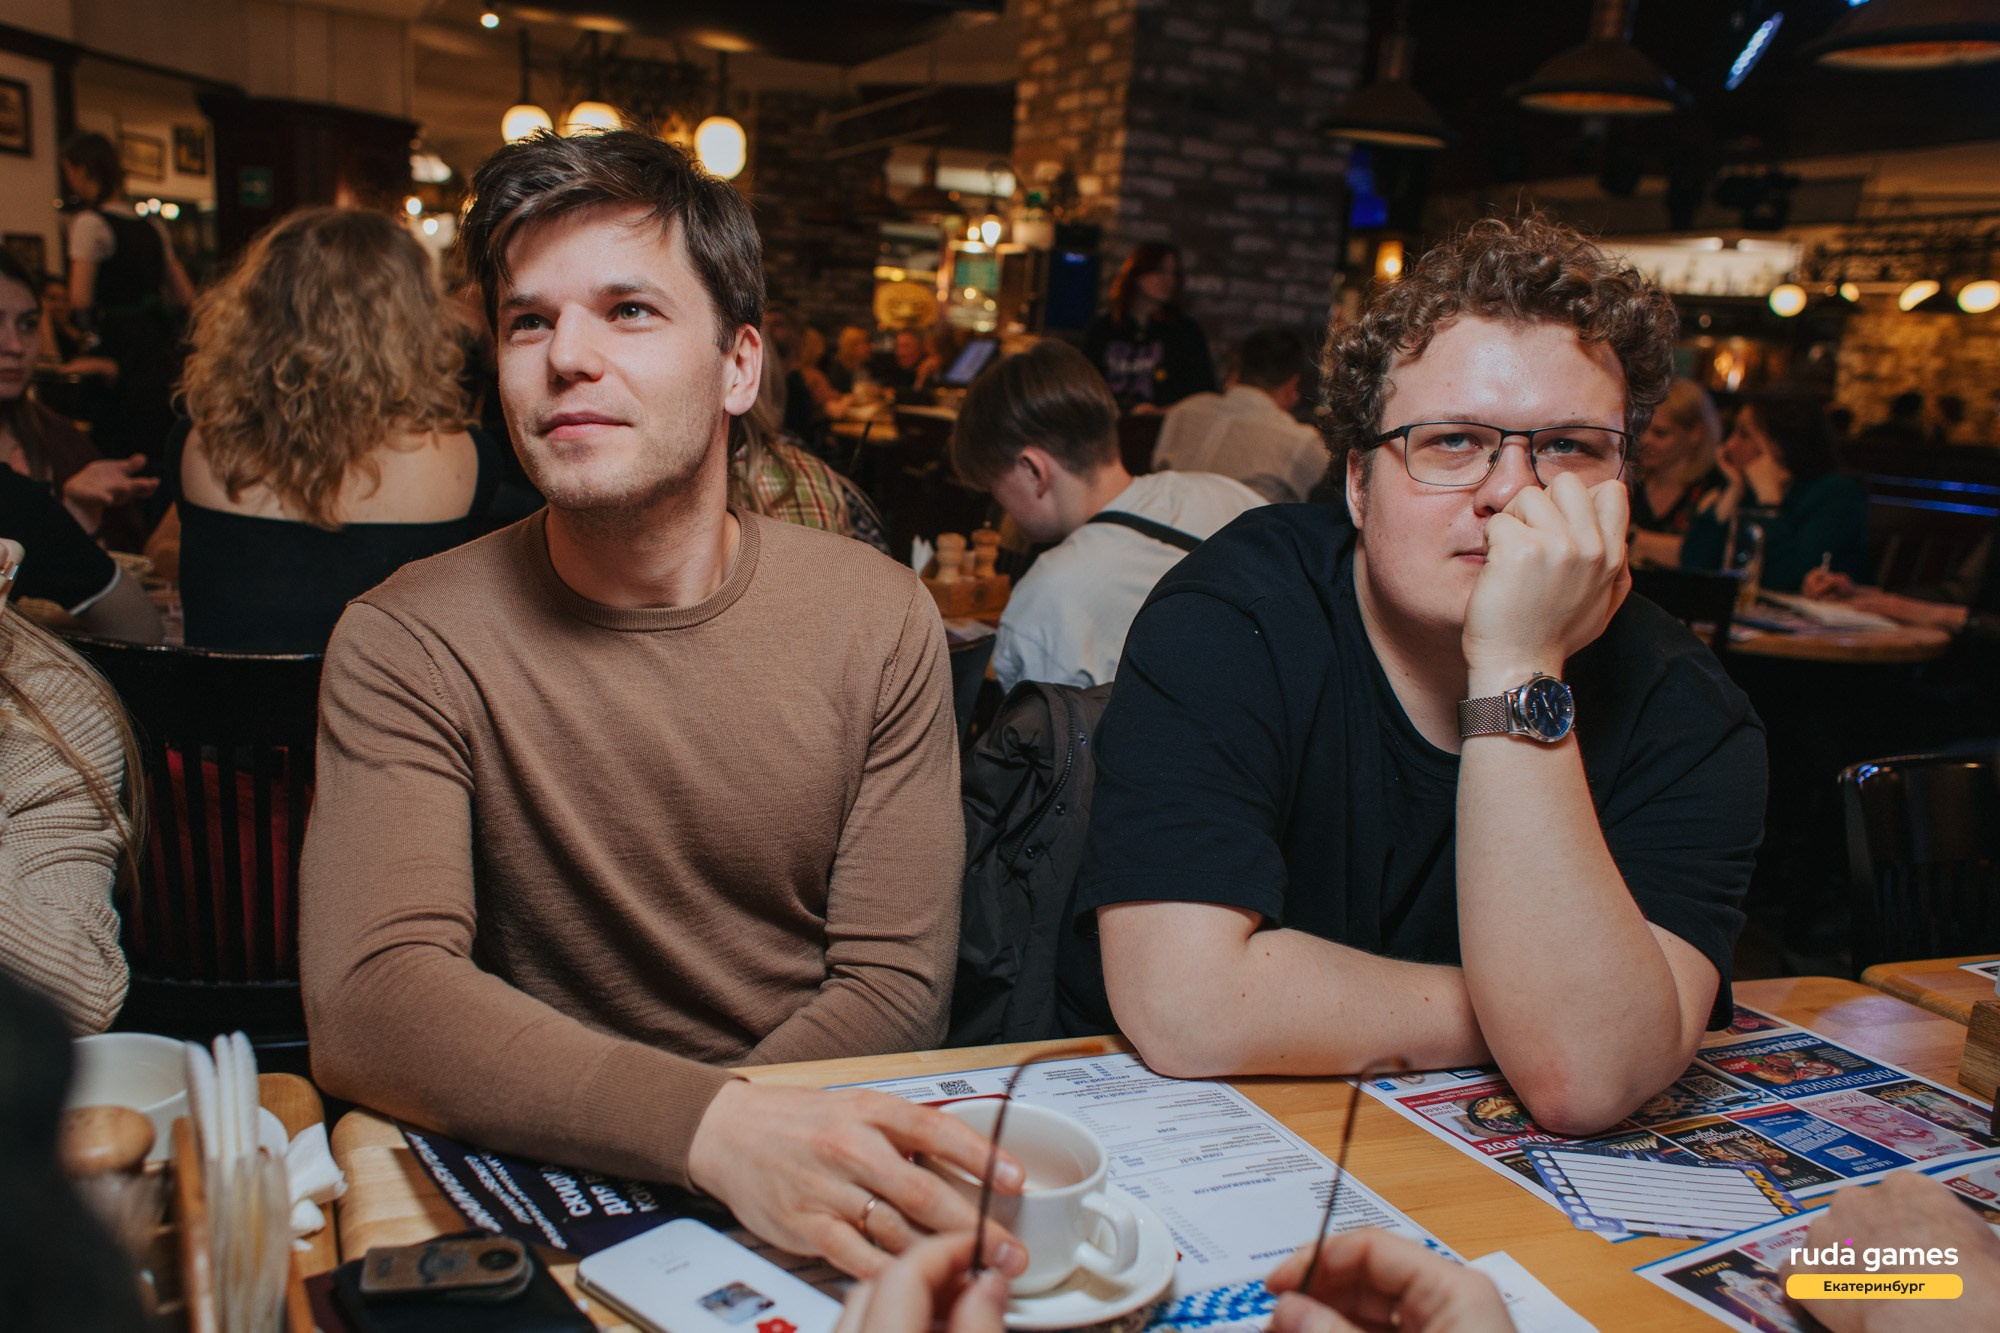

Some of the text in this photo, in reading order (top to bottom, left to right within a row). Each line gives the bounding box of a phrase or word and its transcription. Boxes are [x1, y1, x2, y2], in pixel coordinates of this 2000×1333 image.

[1771, 1069, 1900, 1096] ИМЕНИННИКАМ
[1787, 1126, 1849, 1153] ВЕЧЕРИНКА
[1772, 1235, 1804, 1248] МАРТА
[1699, 1261, 1733, 1275] МАРТА
